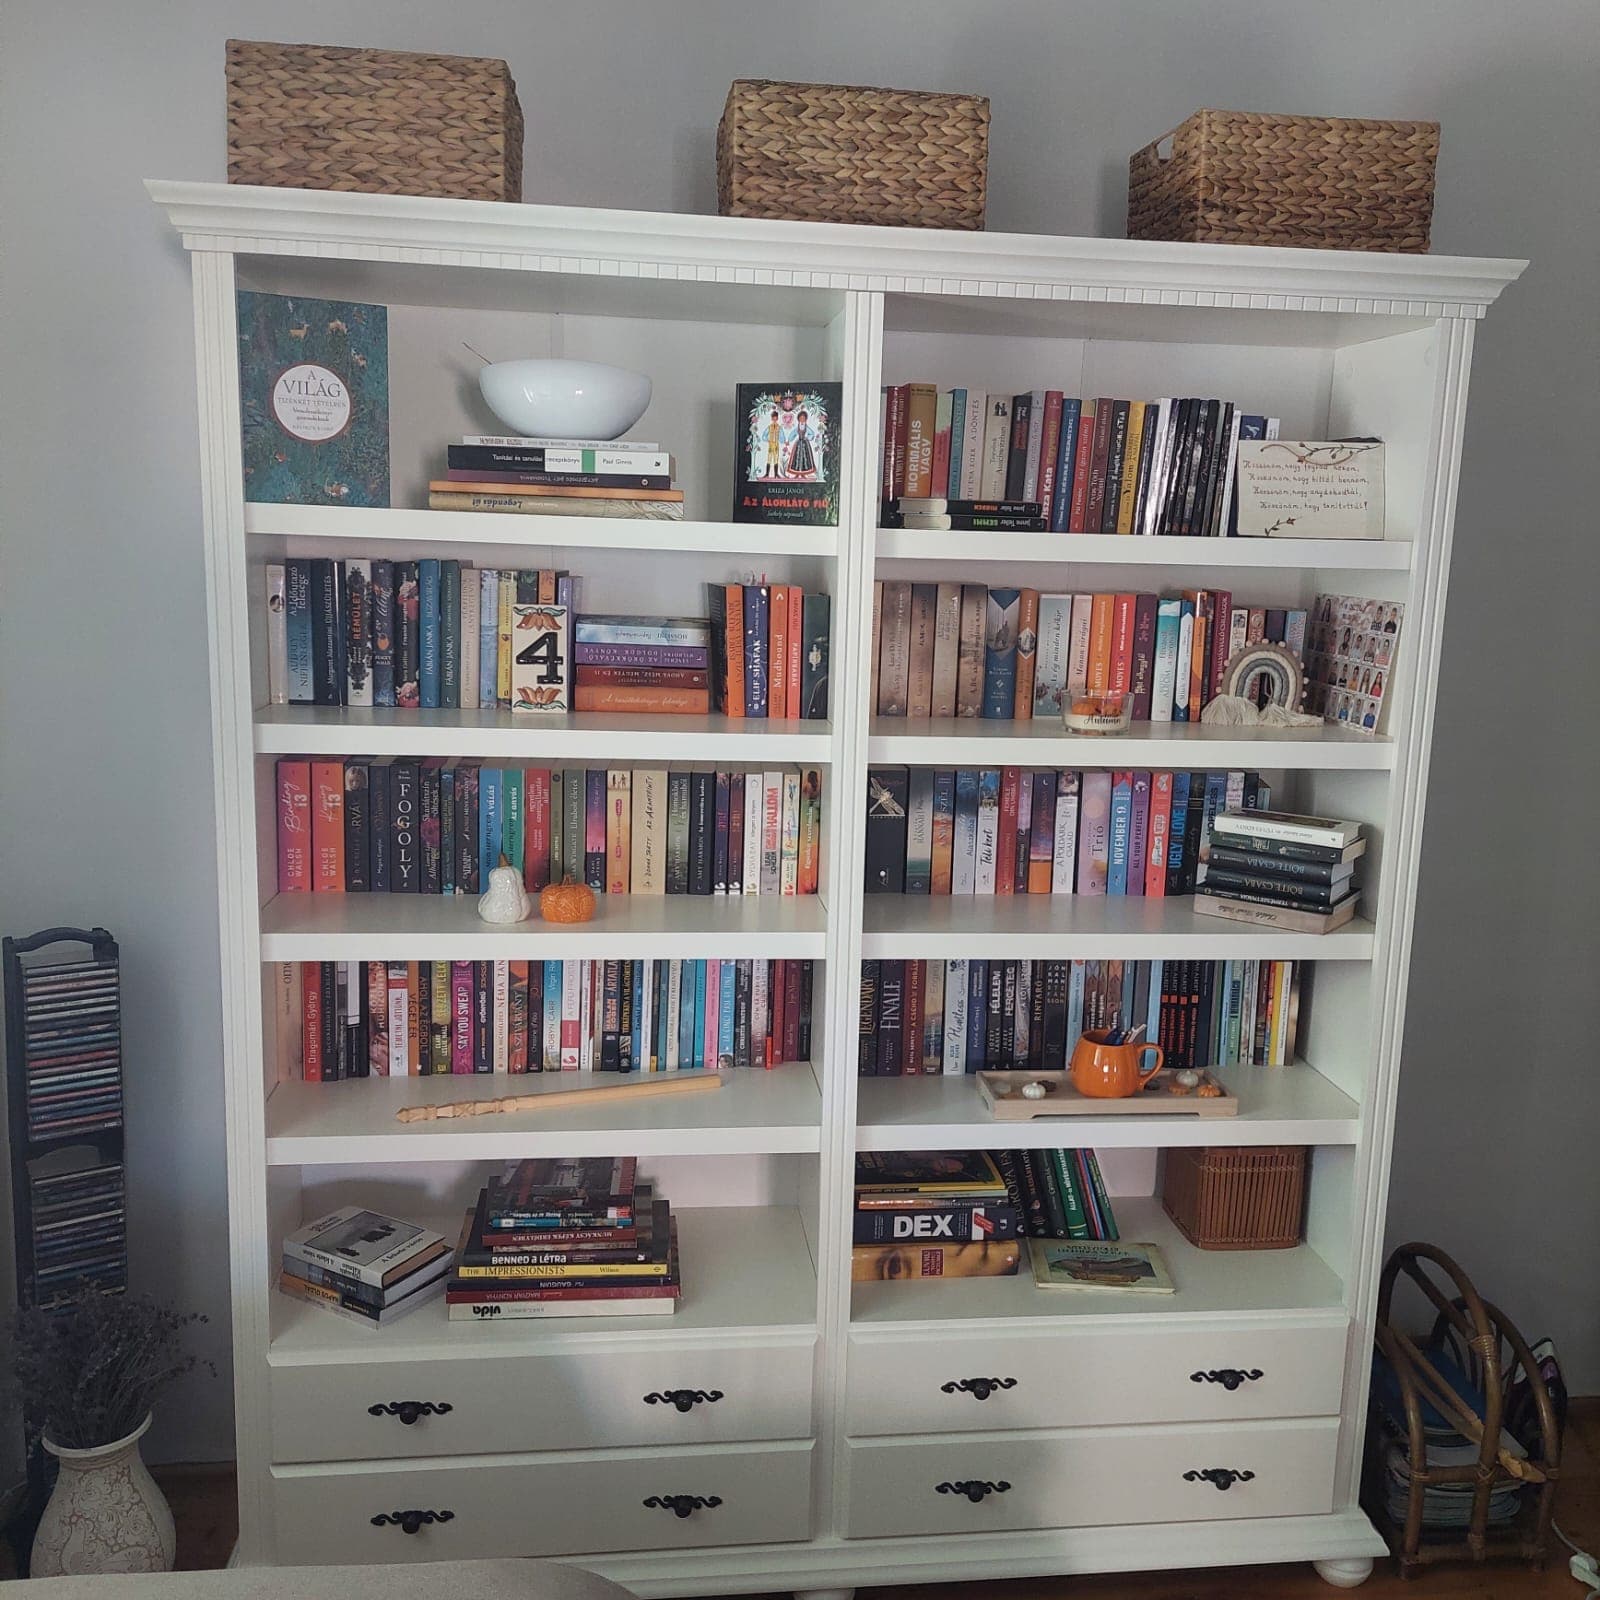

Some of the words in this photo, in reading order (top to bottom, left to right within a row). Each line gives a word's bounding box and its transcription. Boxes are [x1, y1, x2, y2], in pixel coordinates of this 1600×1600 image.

[282, 379, 341, 398] VILÁG
[307, 370, 316, 381] A
[908, 419, 922, 492] NORMÁLIS
[1044, 466, 1054, 492] Kata
[483, 499, 523, 509] Legendás
[516, 632, 564, 685] 4
[752, 639, 761, 678] SHAFAK
[773, 634, 784, 688] Mudbound
[752, 680, 761, 700] ELIF
[1084, 715, 1121, 726] Autumn
[282, 781, 304, 833] Binding
[295, 794, 307, 808] 13
[328, 794, 342, 808] 13
[767, 788, 778, 827] HALLOM
[398, 783, 412, 878] FOGOLY
[1134, 810, 1144, 840] PERFECTS
[1172, 808, 1186, 837] LOVE
[982, 829, 992, 847] kert
[1092, 825, 1104, 856] Trió
[1114, 816, 1127, 865] NOVEMBER
[1134, 842, 1142, 857] YOUR
[1170, 842, 1183, 869] UGLY
[419, 976, 428, 1000] AHOL
[604, 960, 618, 992] ÁRTATLA
[307, 990, 318, 1020] György
[497, 982, 505, 1008] NÉMA
[860, 976, 876, 1035] LEGENDARY
[880, 980, 900, 1030] FINALE
[990, 970, 1001, 1014] FÉLELEM
[420, 1006, 428, 1017] AZ
[458, 1016, 469, 1034] YOU
[308, 1020, 317, 1064] Dragomán
[420, 1019, 430, 1055] ÉGBOLT
[458, 1034, 469, 1050] SAY
[893, 1214, 954, 1238] DEX
[466, 1268, 480, 1276] THE
[484, 1266, 565, 1276] IMPRESSIONISTS
[472, 1304, 501, 1317] vida
